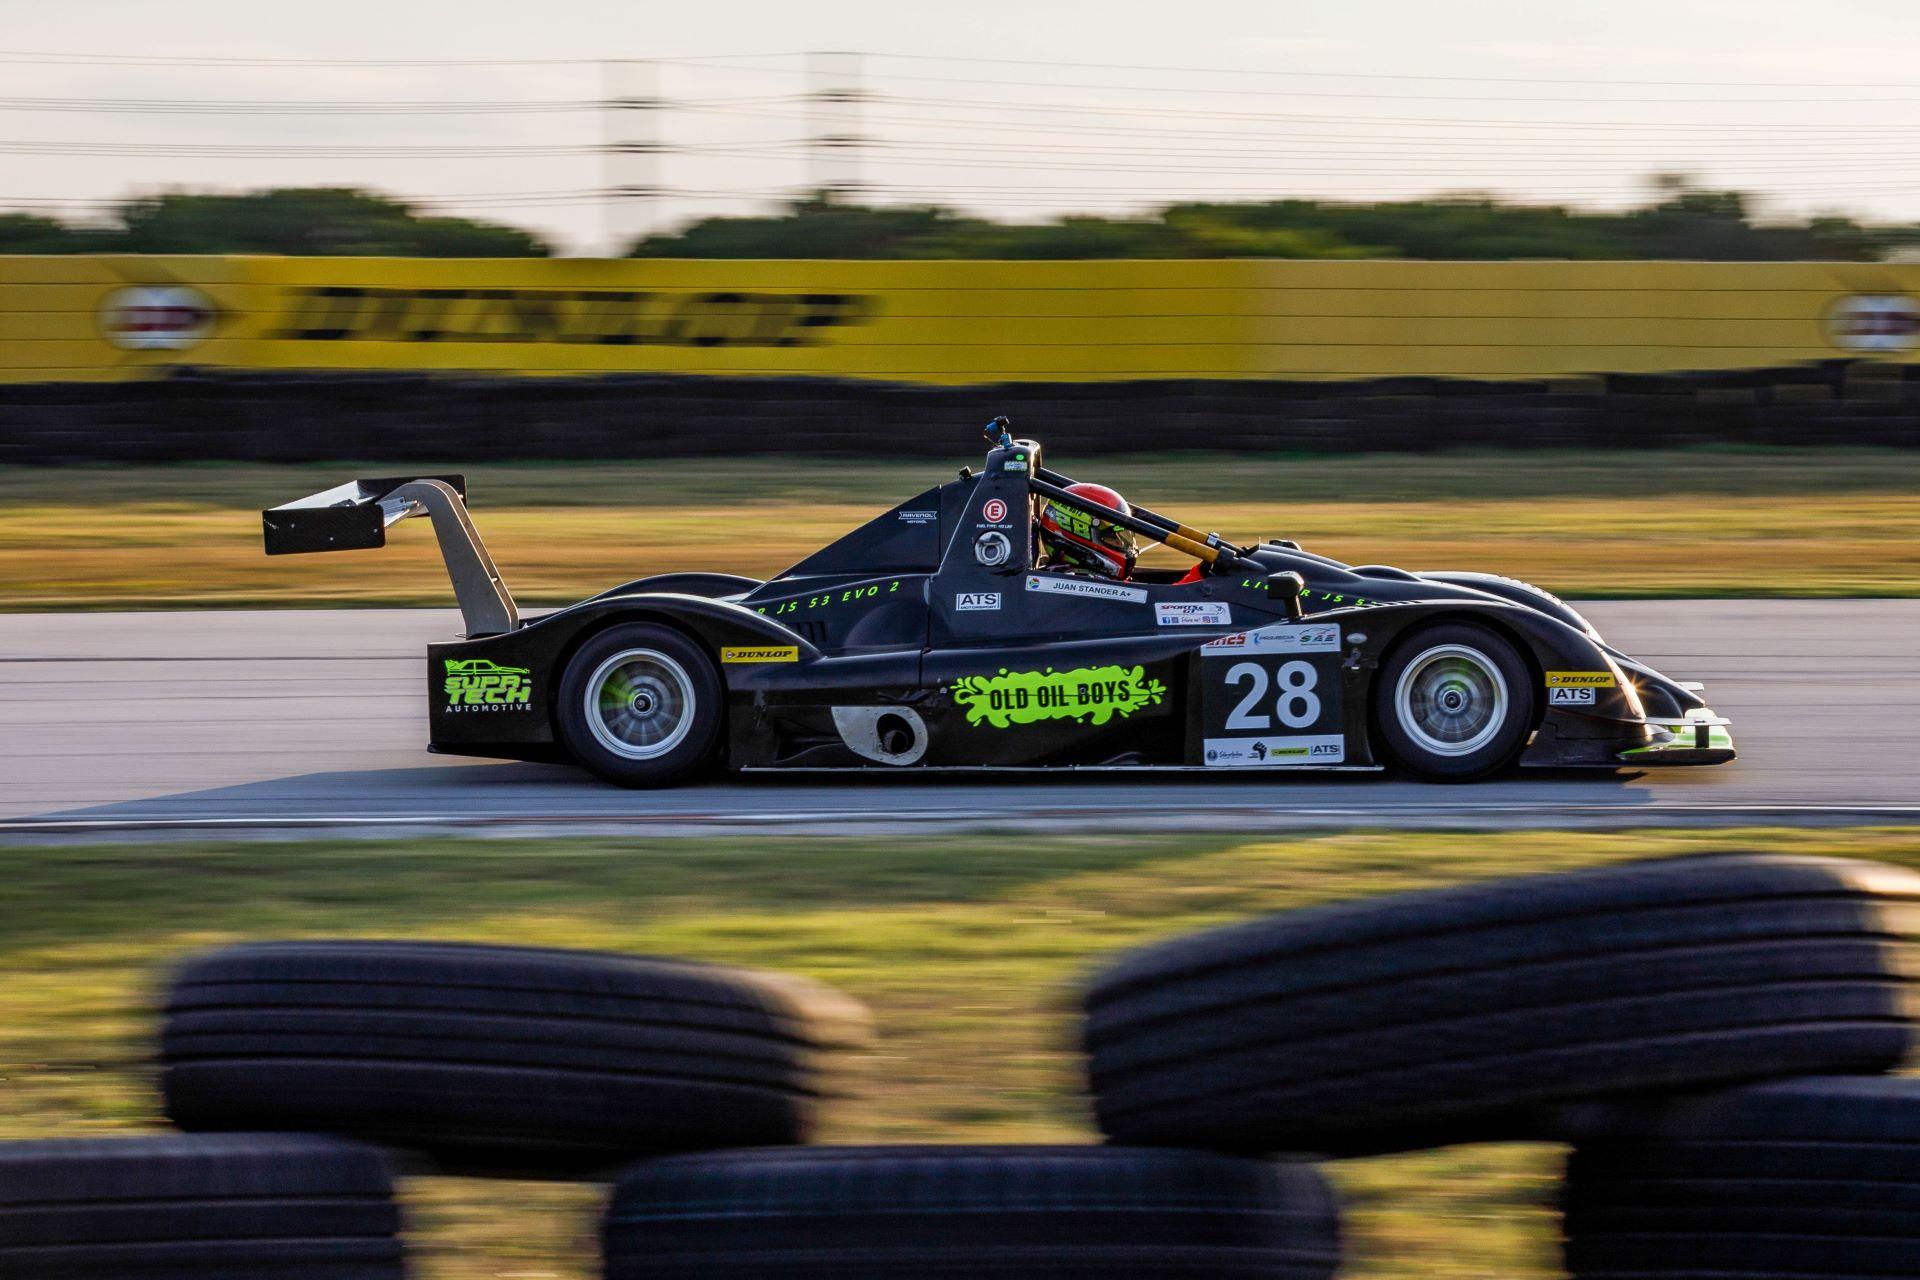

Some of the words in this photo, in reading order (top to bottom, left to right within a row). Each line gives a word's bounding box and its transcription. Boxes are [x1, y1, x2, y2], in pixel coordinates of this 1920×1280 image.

[990, 505, 1000, 517] E
[1053, 582, 1077, 591] JUAN
[1078, 584, 1118, 596] STANDER
[776, 601, 798, 615] JS
[808, 595, 830, 609] 53
[841, 586, 878, 602] EVO
[889, 581, 900, 593] 2
[961, 594, 997, 605] ATS
[1321, 593, 1344, 603] JS
[737, 650, 792, 658] DUNLOP
[444, 687, 531, 704] TECH
[990, 688, 1029, 710] OLD
[1037, 685, 1070, 708] OIL
[1077, 680, 1130, 706] BOYS
[1225, 661, 1321, 730] 28
[1555, 688, 1591, 699] ATS
[445, 704, 532, 713] AUTOMOTIVE
[1313, 744, 1339, 753] ATS
